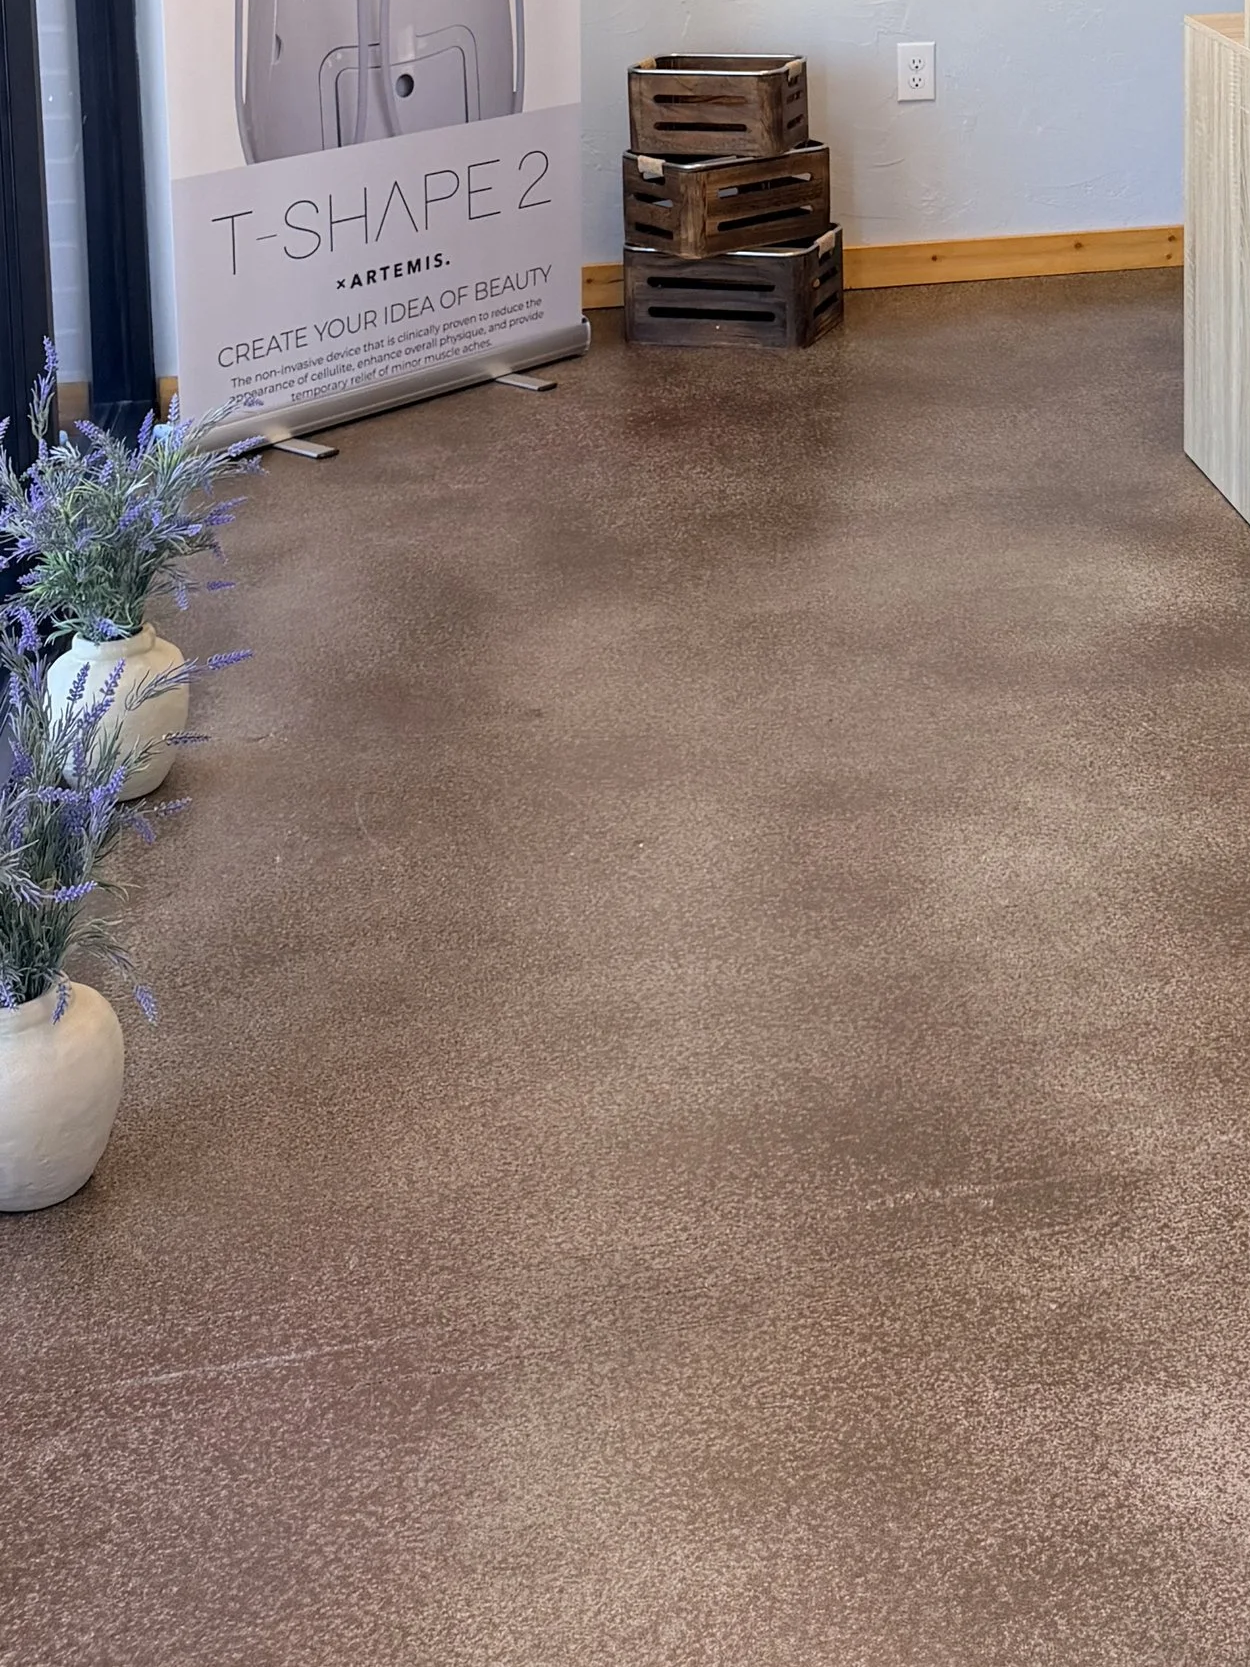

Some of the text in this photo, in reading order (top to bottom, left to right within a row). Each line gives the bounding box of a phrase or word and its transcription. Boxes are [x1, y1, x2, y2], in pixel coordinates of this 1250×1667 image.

[211, 150, 552, 275] T-SHAPE 2
[218, 264, 552, 368] CREATE YOUR IDEA OF BEAUTY
[230, 296, 542, 389] The non-invasive device that is clinically proven to reduce the
[297, 373, 309, 385] of
[310, 361, 356, 382] cellulite,
[356, 349, 401, 370] enhance
[404, 338, 438, 357] overall
[439, 326, 487, 349] physique,
[488, 320, 508, 334] and
[508, 309, 545, 331] provide
[291, 337, 493, 403] temporary relief of minor muscle aches.
